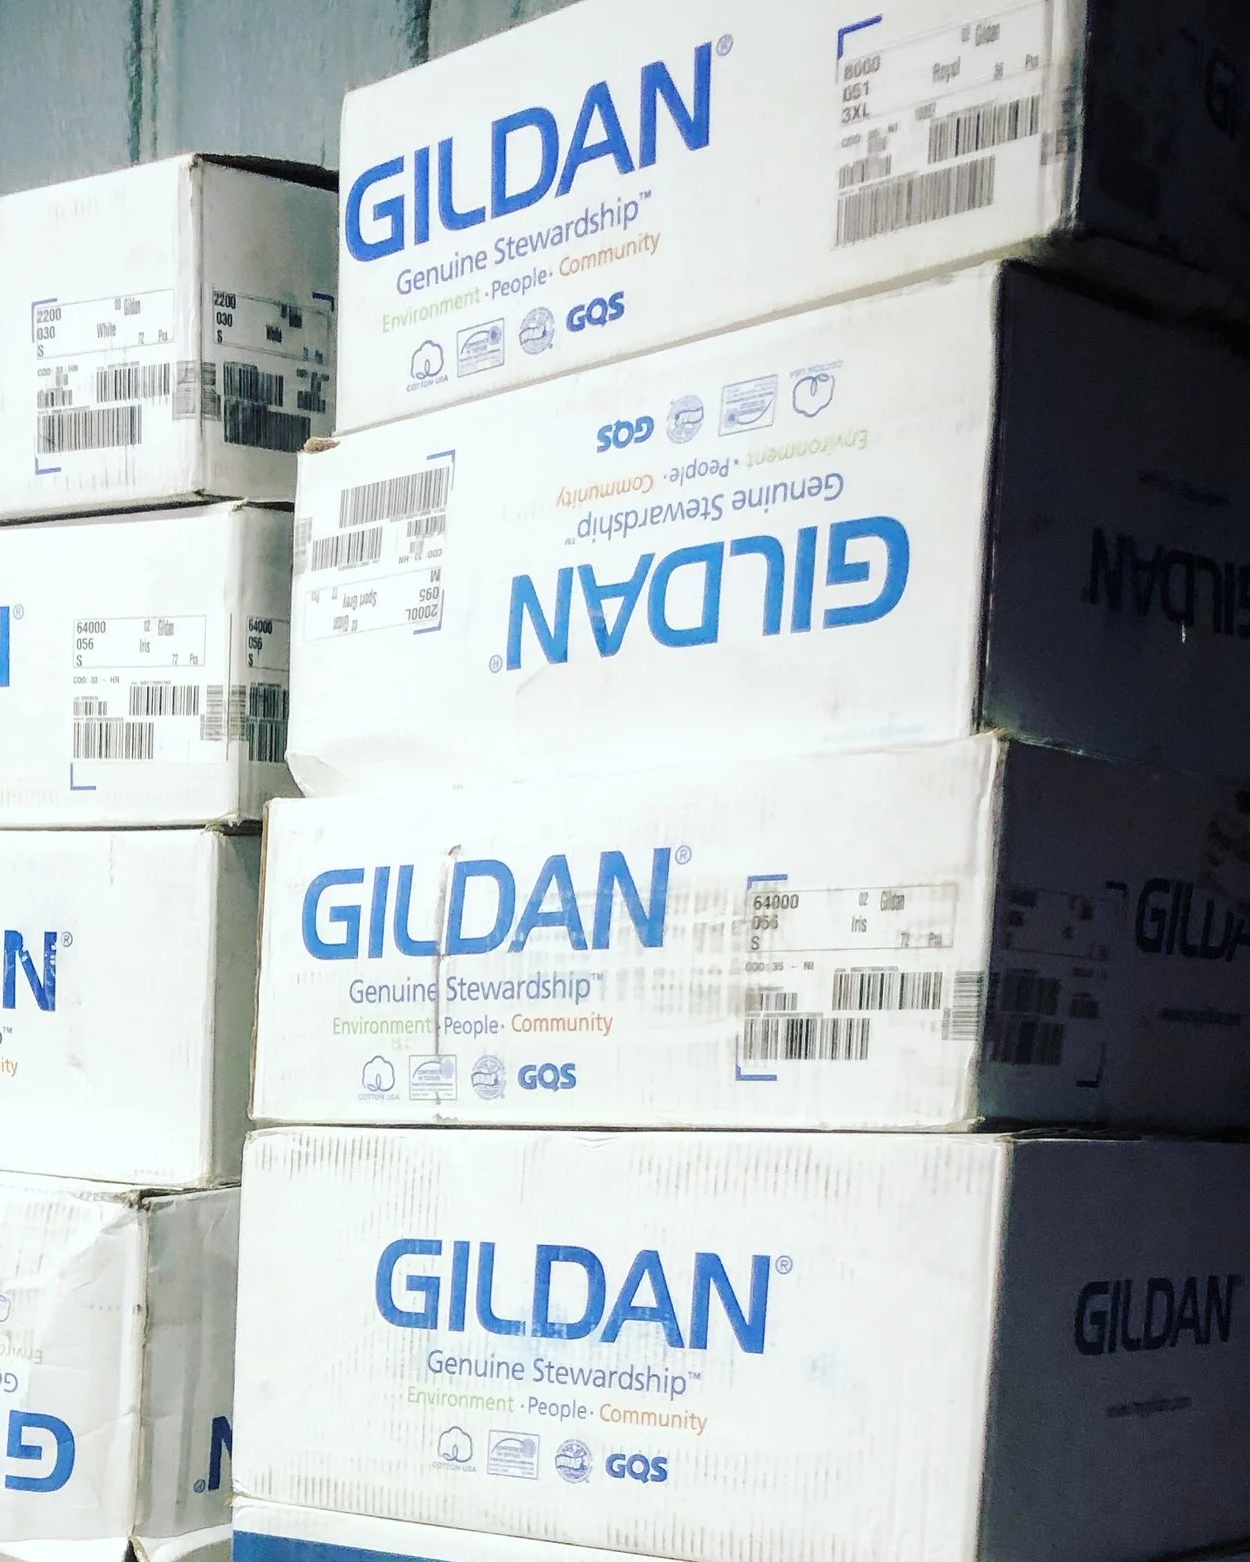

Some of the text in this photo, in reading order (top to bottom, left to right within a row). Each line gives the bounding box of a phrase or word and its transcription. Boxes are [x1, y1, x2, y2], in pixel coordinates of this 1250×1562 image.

[842, 102, 871, 124] 3XL
[345, 42, 713, 263] GILDAN
[396, 197, 639, 295] Genuine Stewardship
[382, 286, 480, 333] Environment
[559, 232, 660, 277] Community
[37, 308, 62, 323] 2200
[566, 291, 625, 332] GQS
[37, 326, 56, 340] 030
[597, 415, 654, 453] GQS
[556, 474, 654, 506] Community
[732, 472, 844, 513] Genuine
[77, 621, 106, 634] 64000
[77, 638, 94, 650] 056
[303, 847, 670, 961] GILDAN
[753, 894, 799, 910] 64000
[349, 971, 591, 1005] Genuine Stewardship
[332, 1012, 613, 1037] Environment Community
[518, 1063, 577, 1093] GQS
[375, 1237, 770, 1356] GILDAN
[427, 1350, 687, 1401] Genuine Stewardship
[407, 1386, 707, 1436] Environment Community
[605, 1452, 668, 1484] GQS
